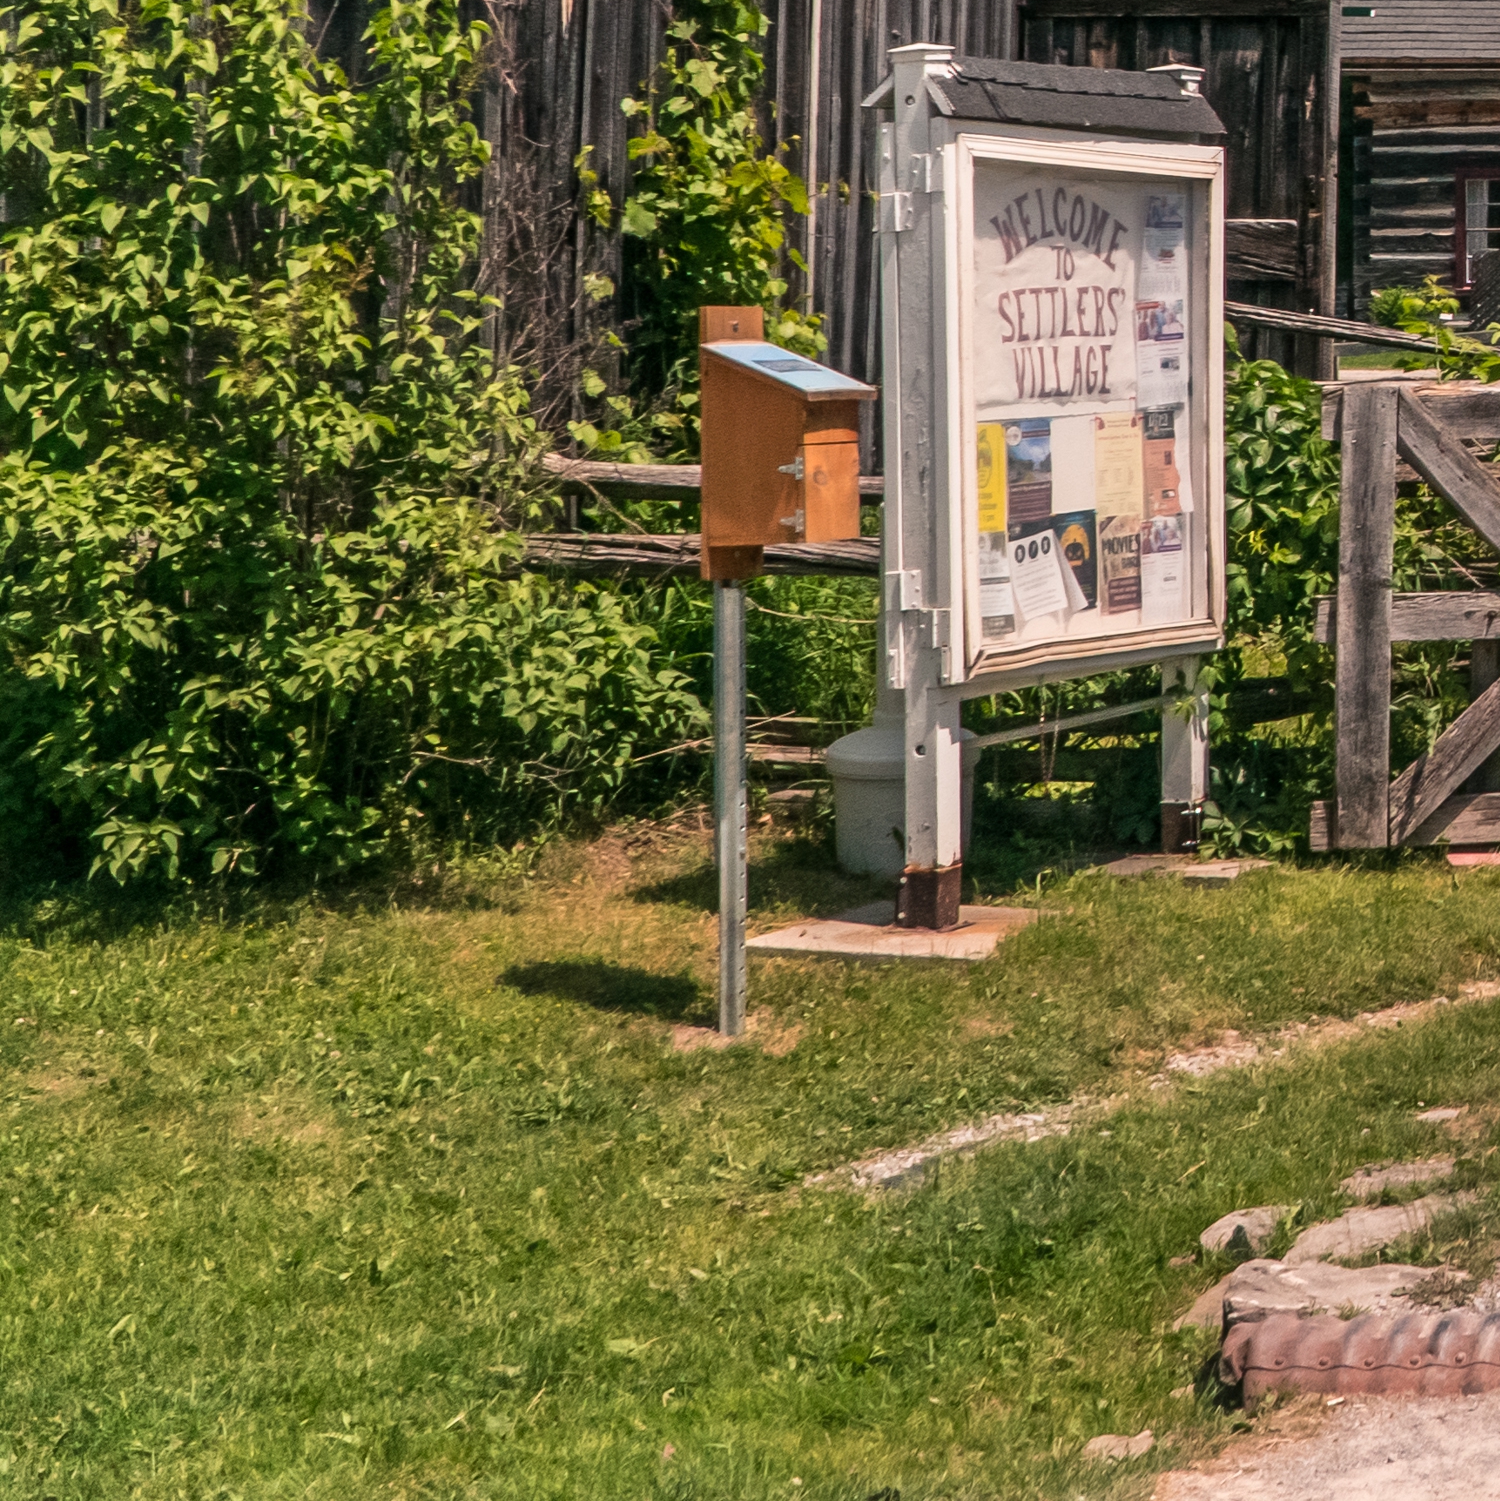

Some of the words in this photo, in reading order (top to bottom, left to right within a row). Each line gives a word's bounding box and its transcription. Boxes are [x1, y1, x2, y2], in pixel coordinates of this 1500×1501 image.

[989, 186, 1129, 272] WELCOME
[1050, 244, 1076, 281] TO
[998, 285, 1126, 344] SETTLERS'
[1012, 344, 1113, 400] VILLAGE
